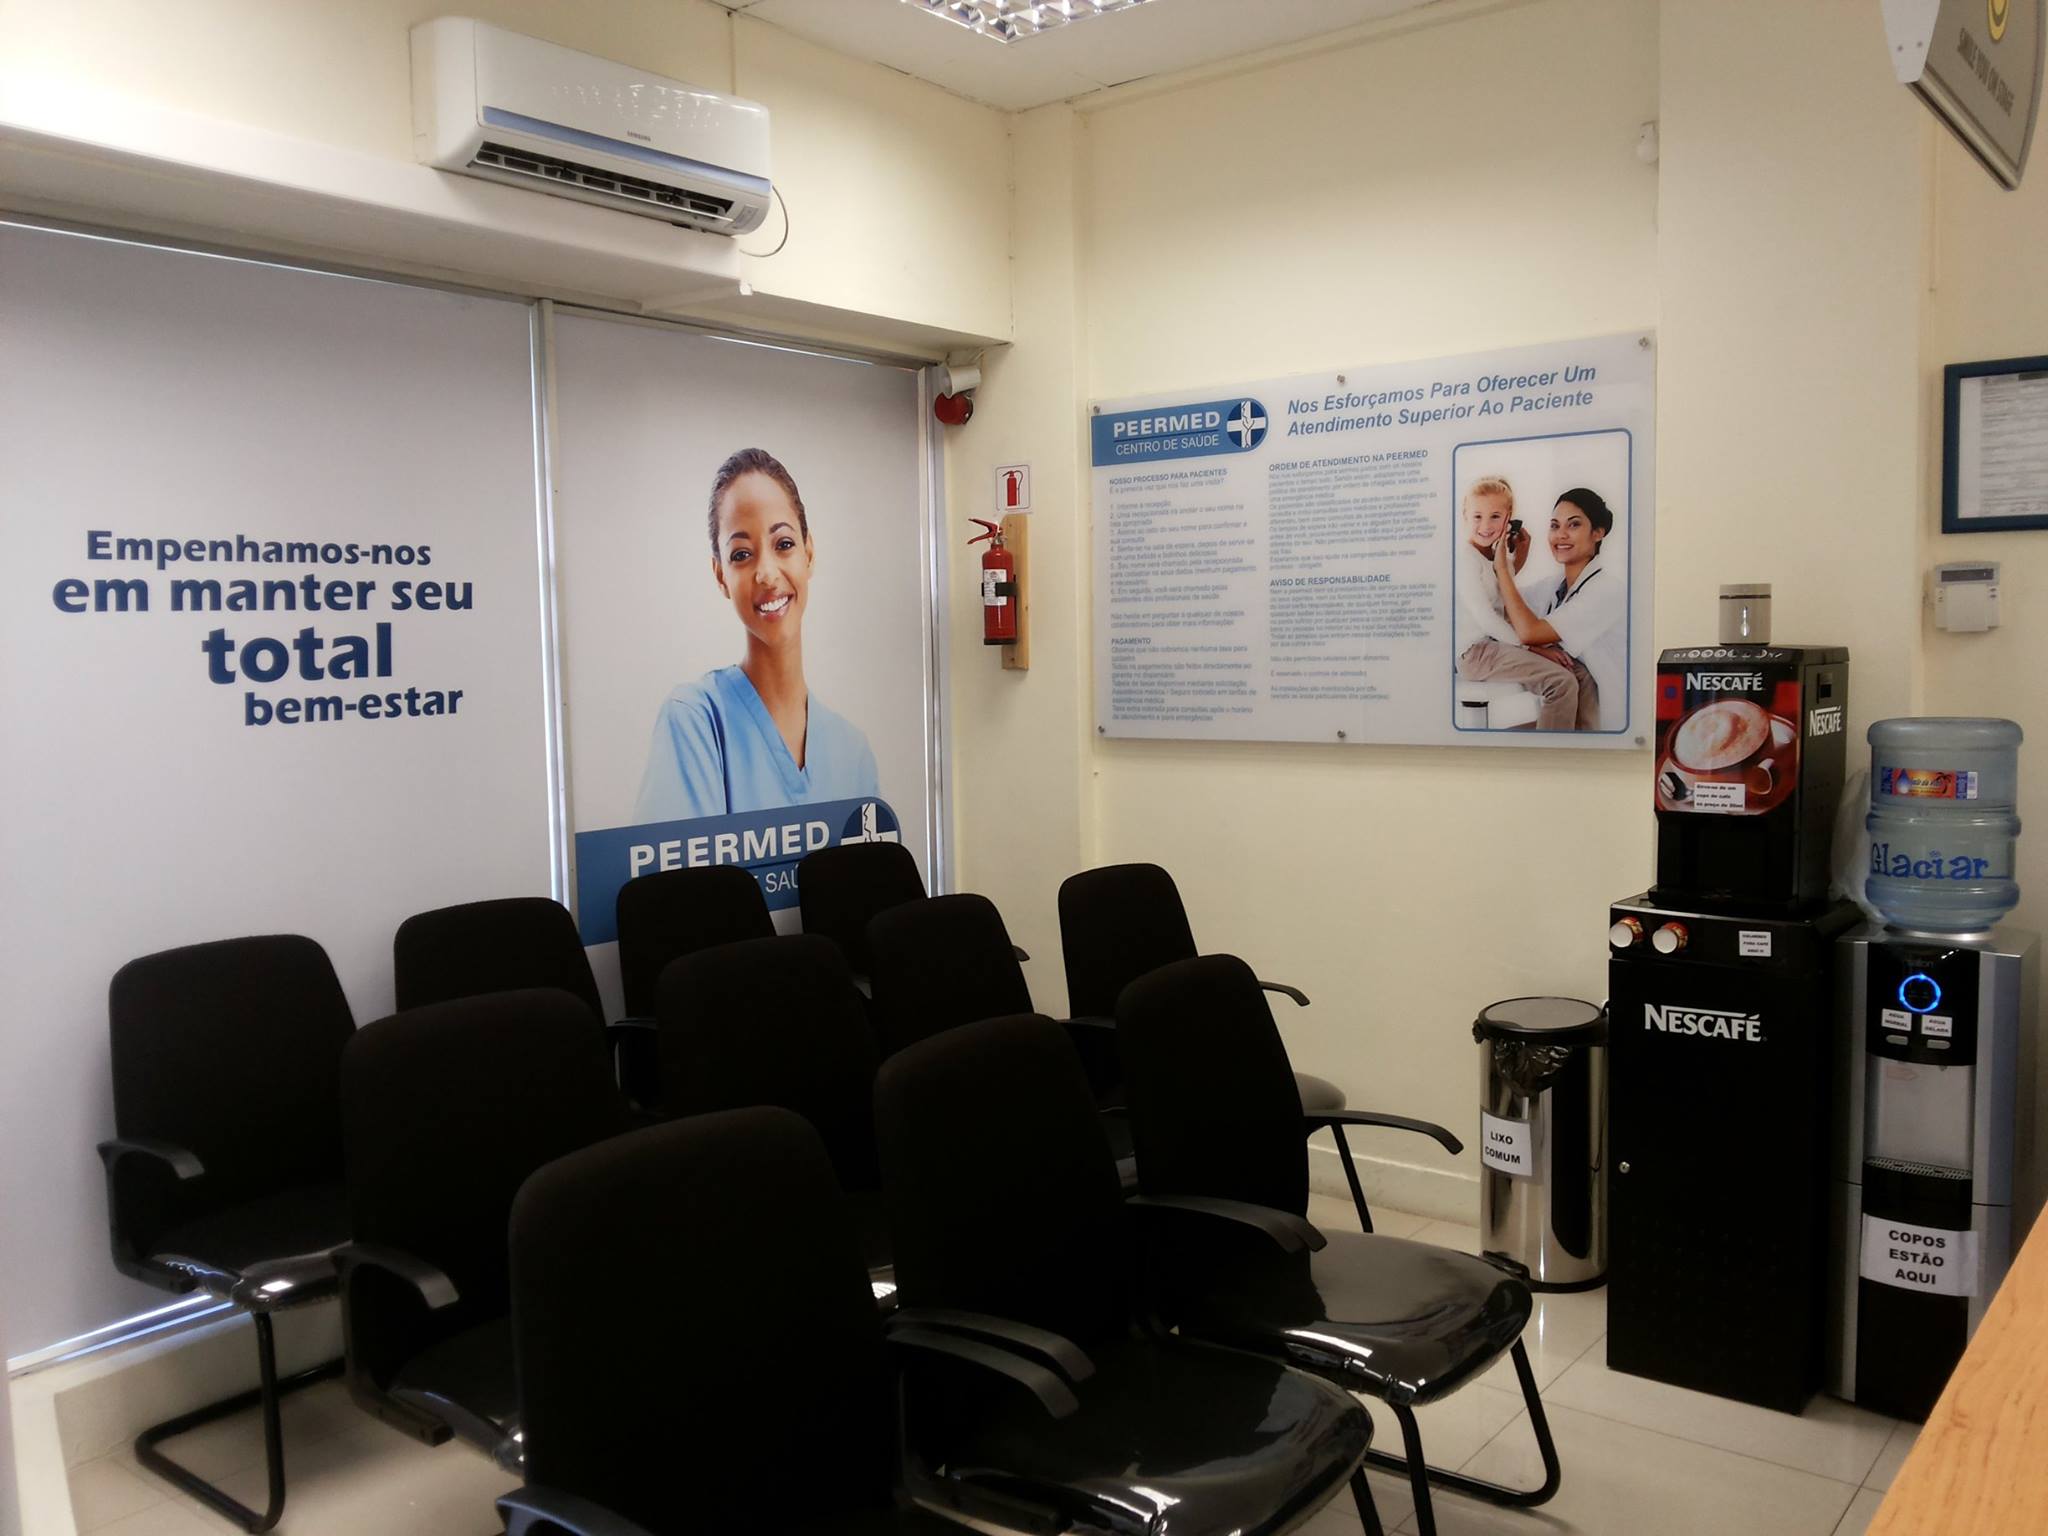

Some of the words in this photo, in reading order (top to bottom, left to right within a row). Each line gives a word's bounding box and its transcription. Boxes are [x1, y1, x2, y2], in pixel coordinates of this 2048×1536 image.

[1288, 399, 1319, 415] Nos
[1324, 386, 1424, 412] Esforçamos
[1431, 382, 1470, 399] Para
[1477, 372, 1558, 393] Oferecer
[1564, 366, 1597, 383] Um
[1113, 411, 1220, 438] PEERMED
[1288, 415, 1392, 436] Atendimento
[1398, 404, 1474, 427] Superior
[1479, 399, 1504, 415] Ao
[1510, 390, 1593, 413] Paciente
[1116, 441, 1160, 456] CENTRO
[1163, 439, 1179, 452] DE
[1181, 432, 1220, 450] SAÚDE
[1313, 456, 1370, 468] ATENDIMENTO
[1386, 450, 1428, 461] PEERMED
[1134, 474, 1169, 482] PROCESSO
[1190, 468, 1227, 478] PACIENTES
[87, 530, 431, 570] Empenhamos-nos
[1308, 575, 1390, 584] RESPONSABILIDADE
[53, 578, 149, 613] em
[171, 574, 376, 611] manter
[391, 579, 473, 611] seu
[202, 622, 392, 684] total
[1686, 672, 1763, 690] NESCAFÉ
[245, 687, 463, 726] bem-estar
[1810, 706, 1841, 736] NESCAFÉ
[630, 821, 830, 878] PEERMED
[1644, 1003, 1761, 1042] NESCAFÉ
[1490, 1131, 1513, 1145] LIXO
[1485, 1146, 1520, 1164] COMUM
[1889, 1230, 1945, 1248] COPOS
[1889, 1249, 1944, 1267] ESTÃO
[1895, 1269, 1935, 1284] AQUI
